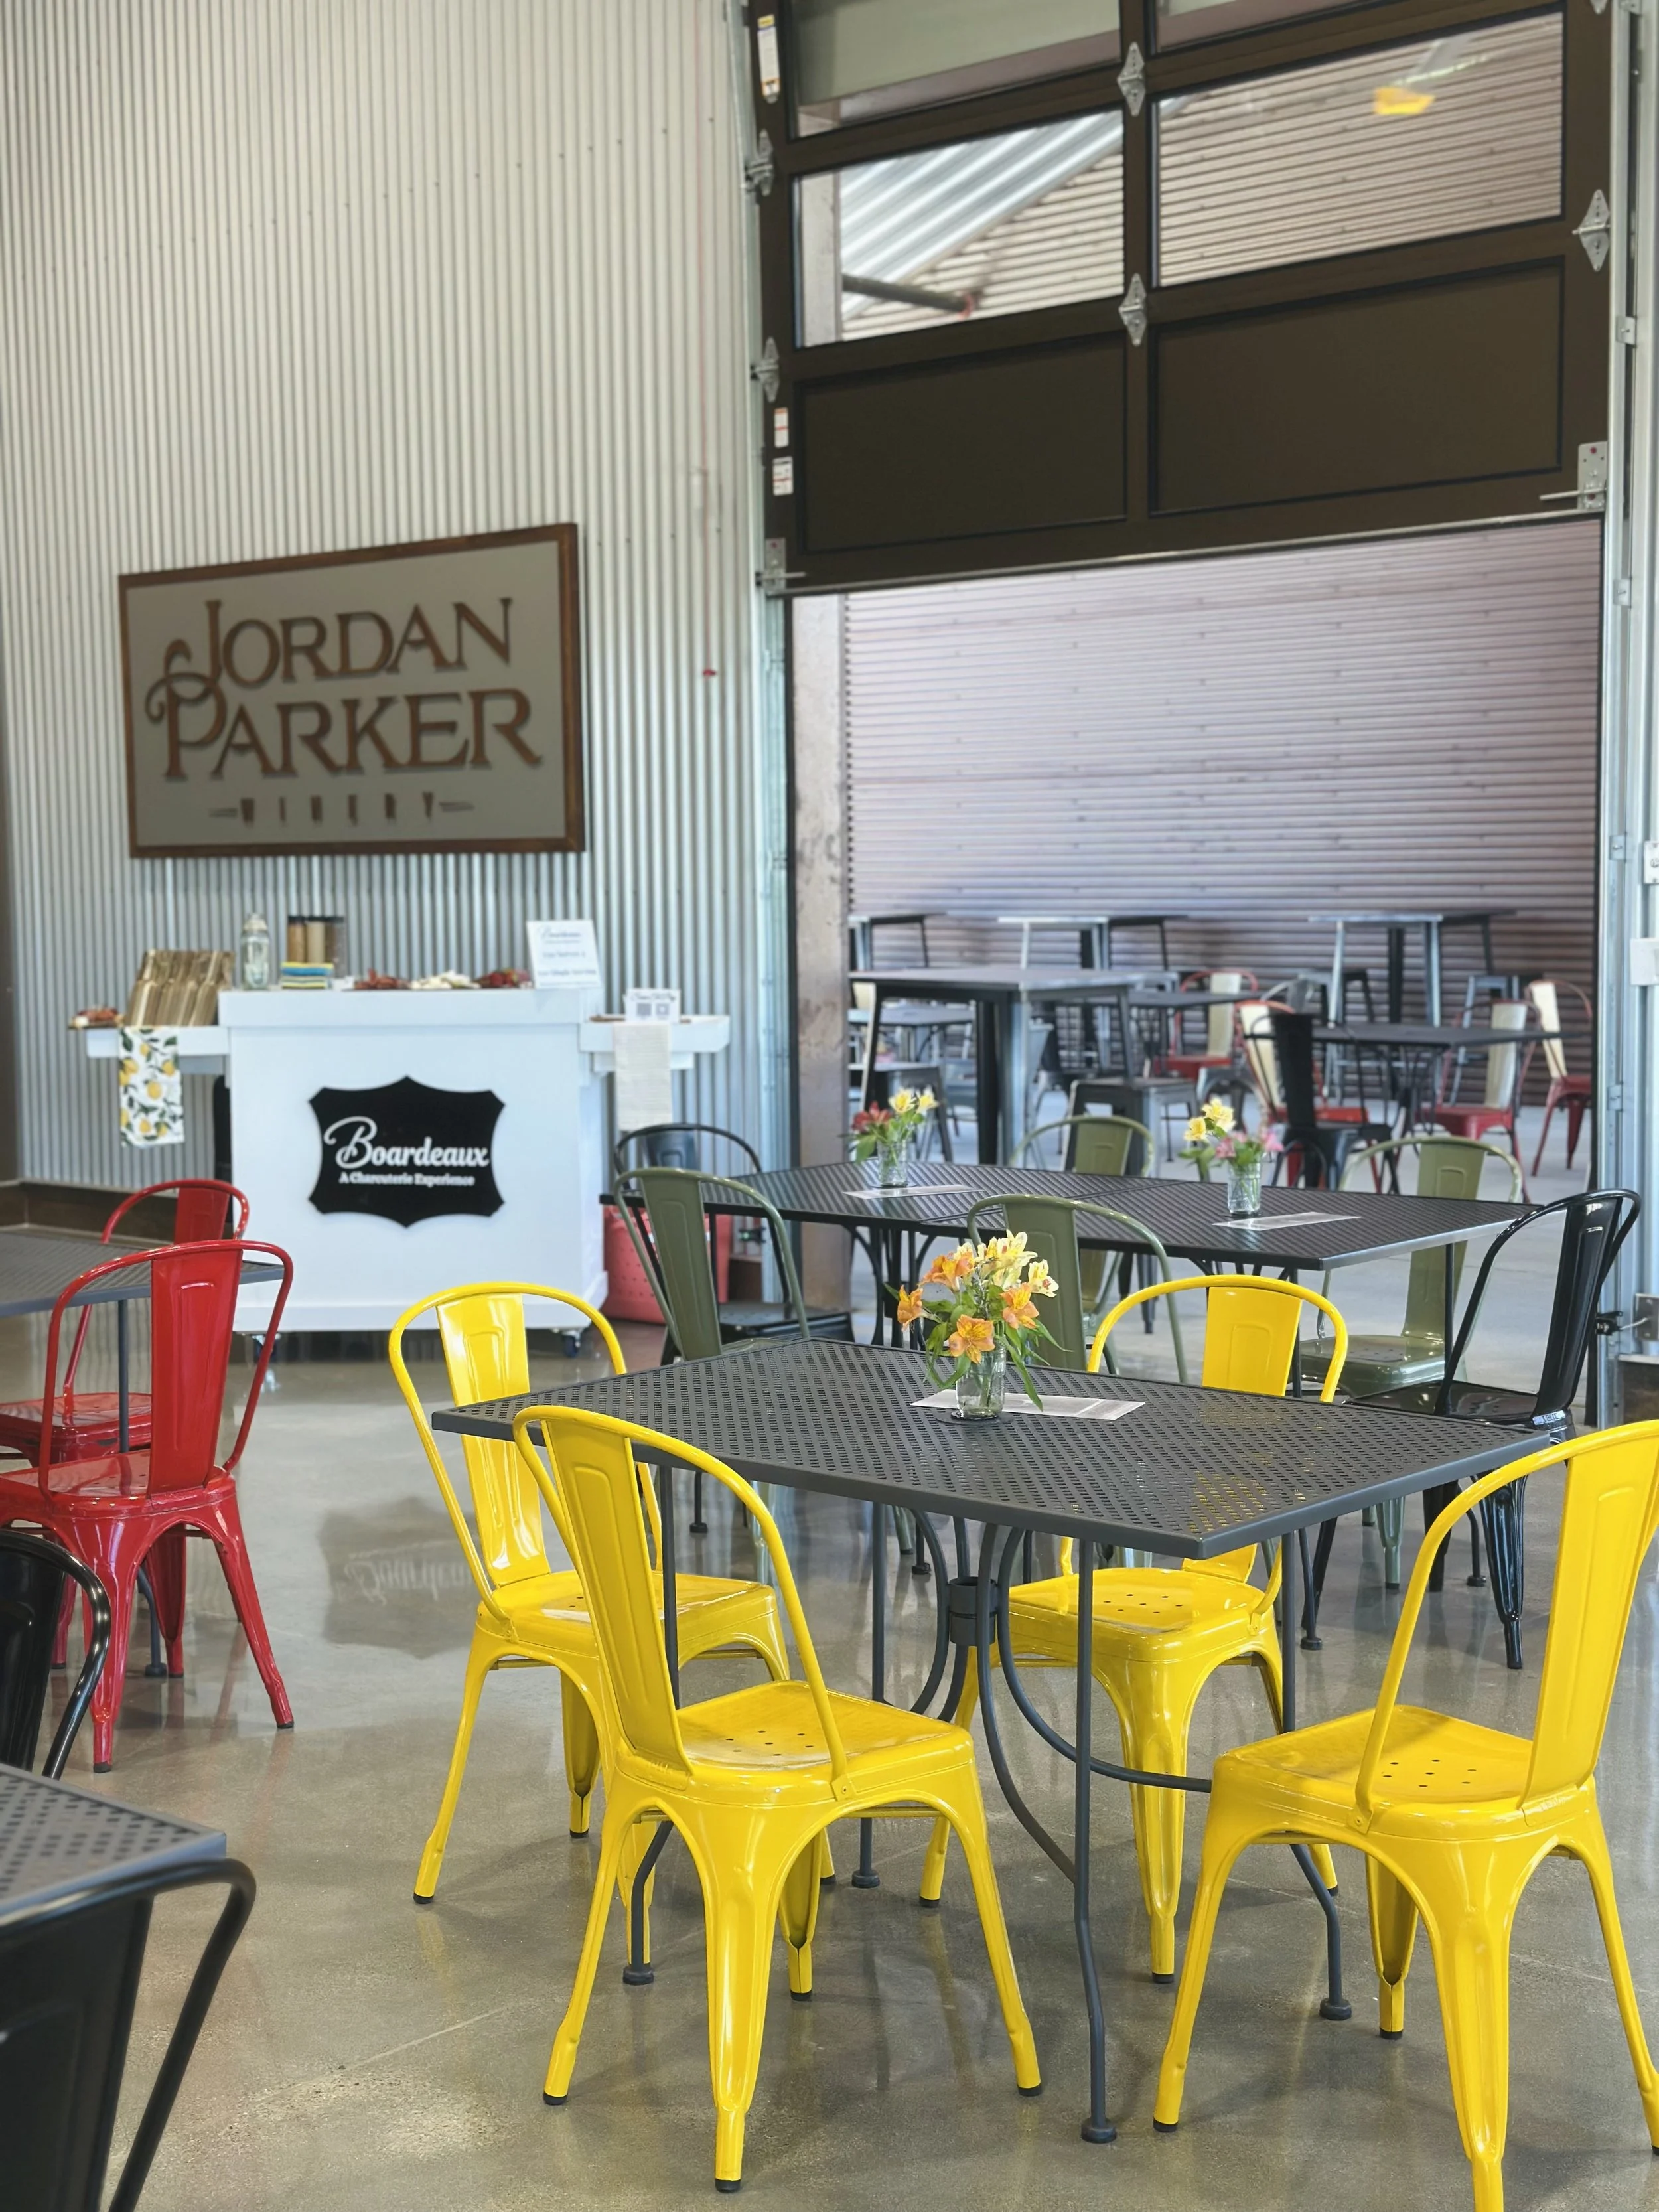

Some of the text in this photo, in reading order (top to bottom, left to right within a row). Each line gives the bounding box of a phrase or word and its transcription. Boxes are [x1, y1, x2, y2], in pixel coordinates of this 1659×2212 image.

[164, 597, 513, 703] JORDAN
[145, 672, 543, 782] PARKER
[323, 1116, 490, 1169] Boardeaux
[338, 1171, 475, 1188] A Charcuterie Experience
